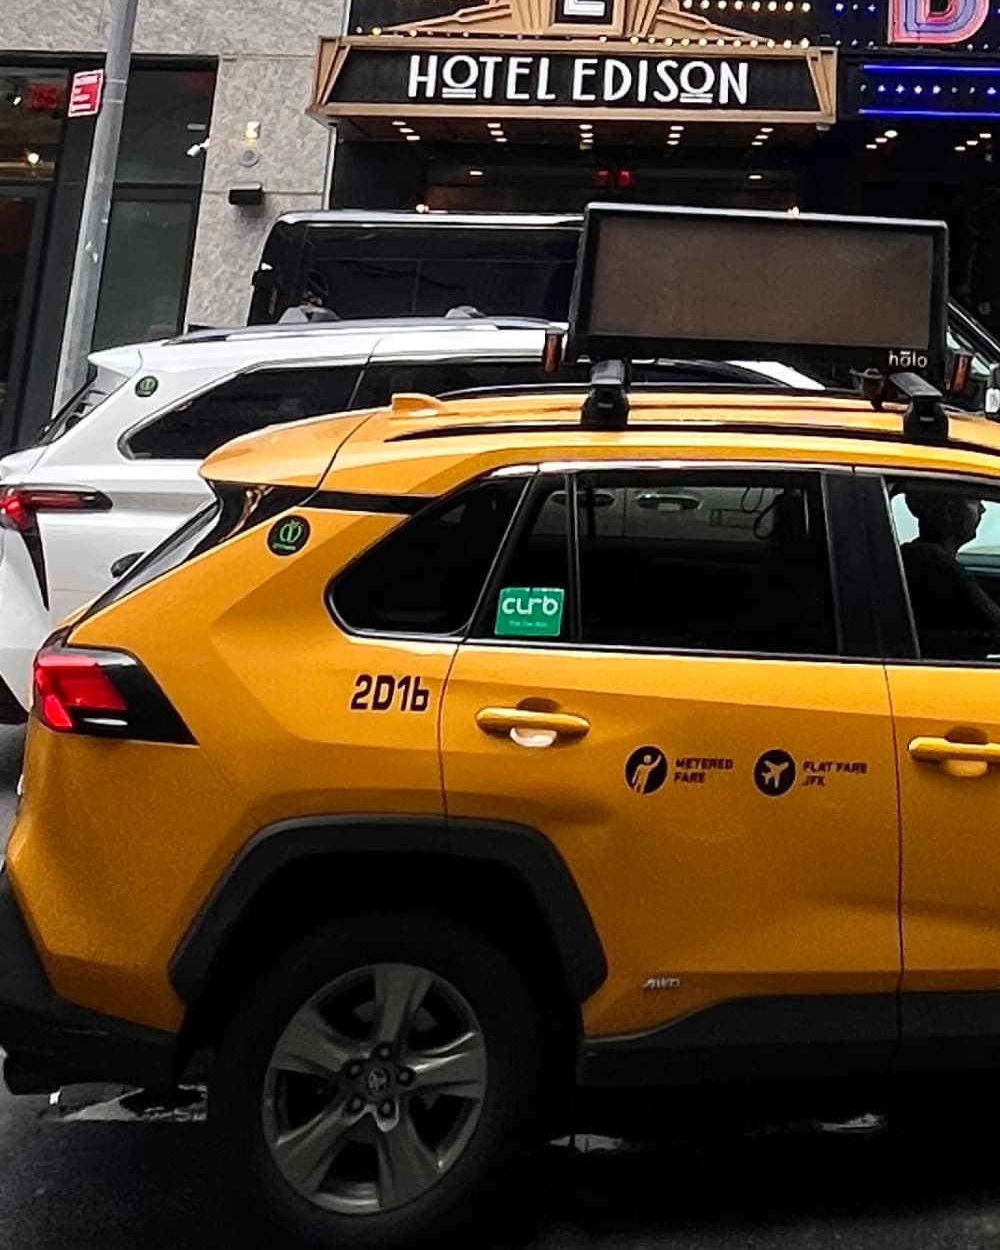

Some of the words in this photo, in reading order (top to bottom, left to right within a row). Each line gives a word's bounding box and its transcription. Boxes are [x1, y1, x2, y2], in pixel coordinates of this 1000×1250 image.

[408, 54, 556, 101] HOTEL
[572, 57, 750, 106] EDISON
[502, 595, 559, 616] curb
[675, 757, 734, 771] METERED
[802, 761, 833, 774] FLAT
[836, 762, 868, 775] FARE
[674, 771, 706, 784] FARE
[802, 774, 826, 787] JFK
